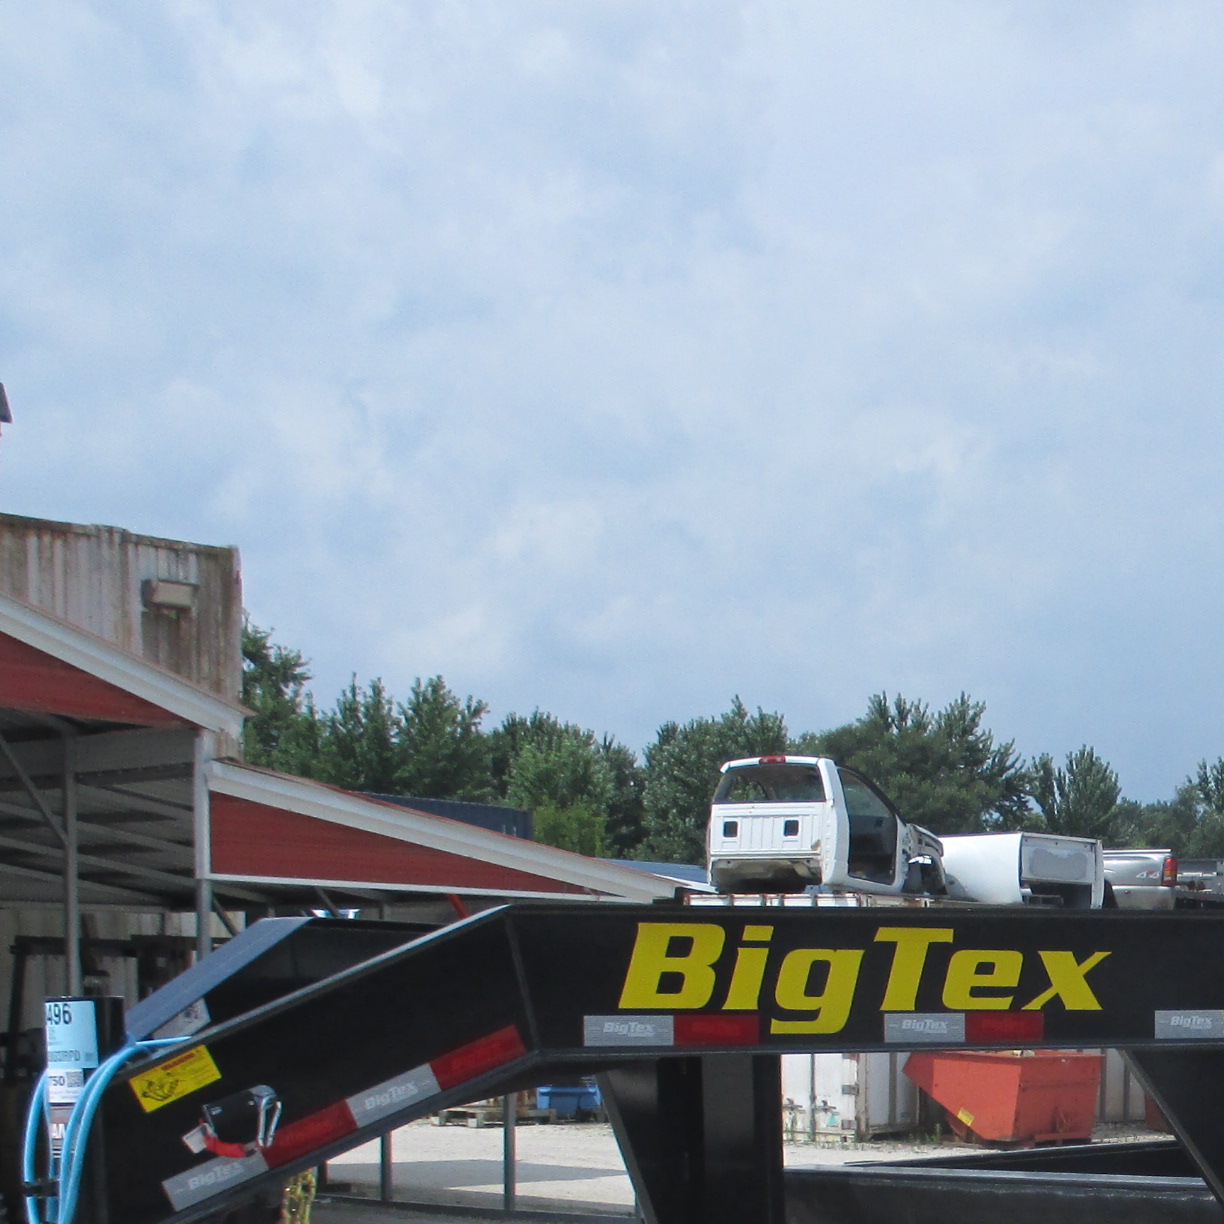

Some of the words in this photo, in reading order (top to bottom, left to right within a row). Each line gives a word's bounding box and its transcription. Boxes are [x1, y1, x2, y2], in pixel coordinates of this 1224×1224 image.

[617, 922, 1112, 1035] BigTex
[603, 1021, 656, 1036] BigTex
[902, 1019, 949, 1032] BigTex
